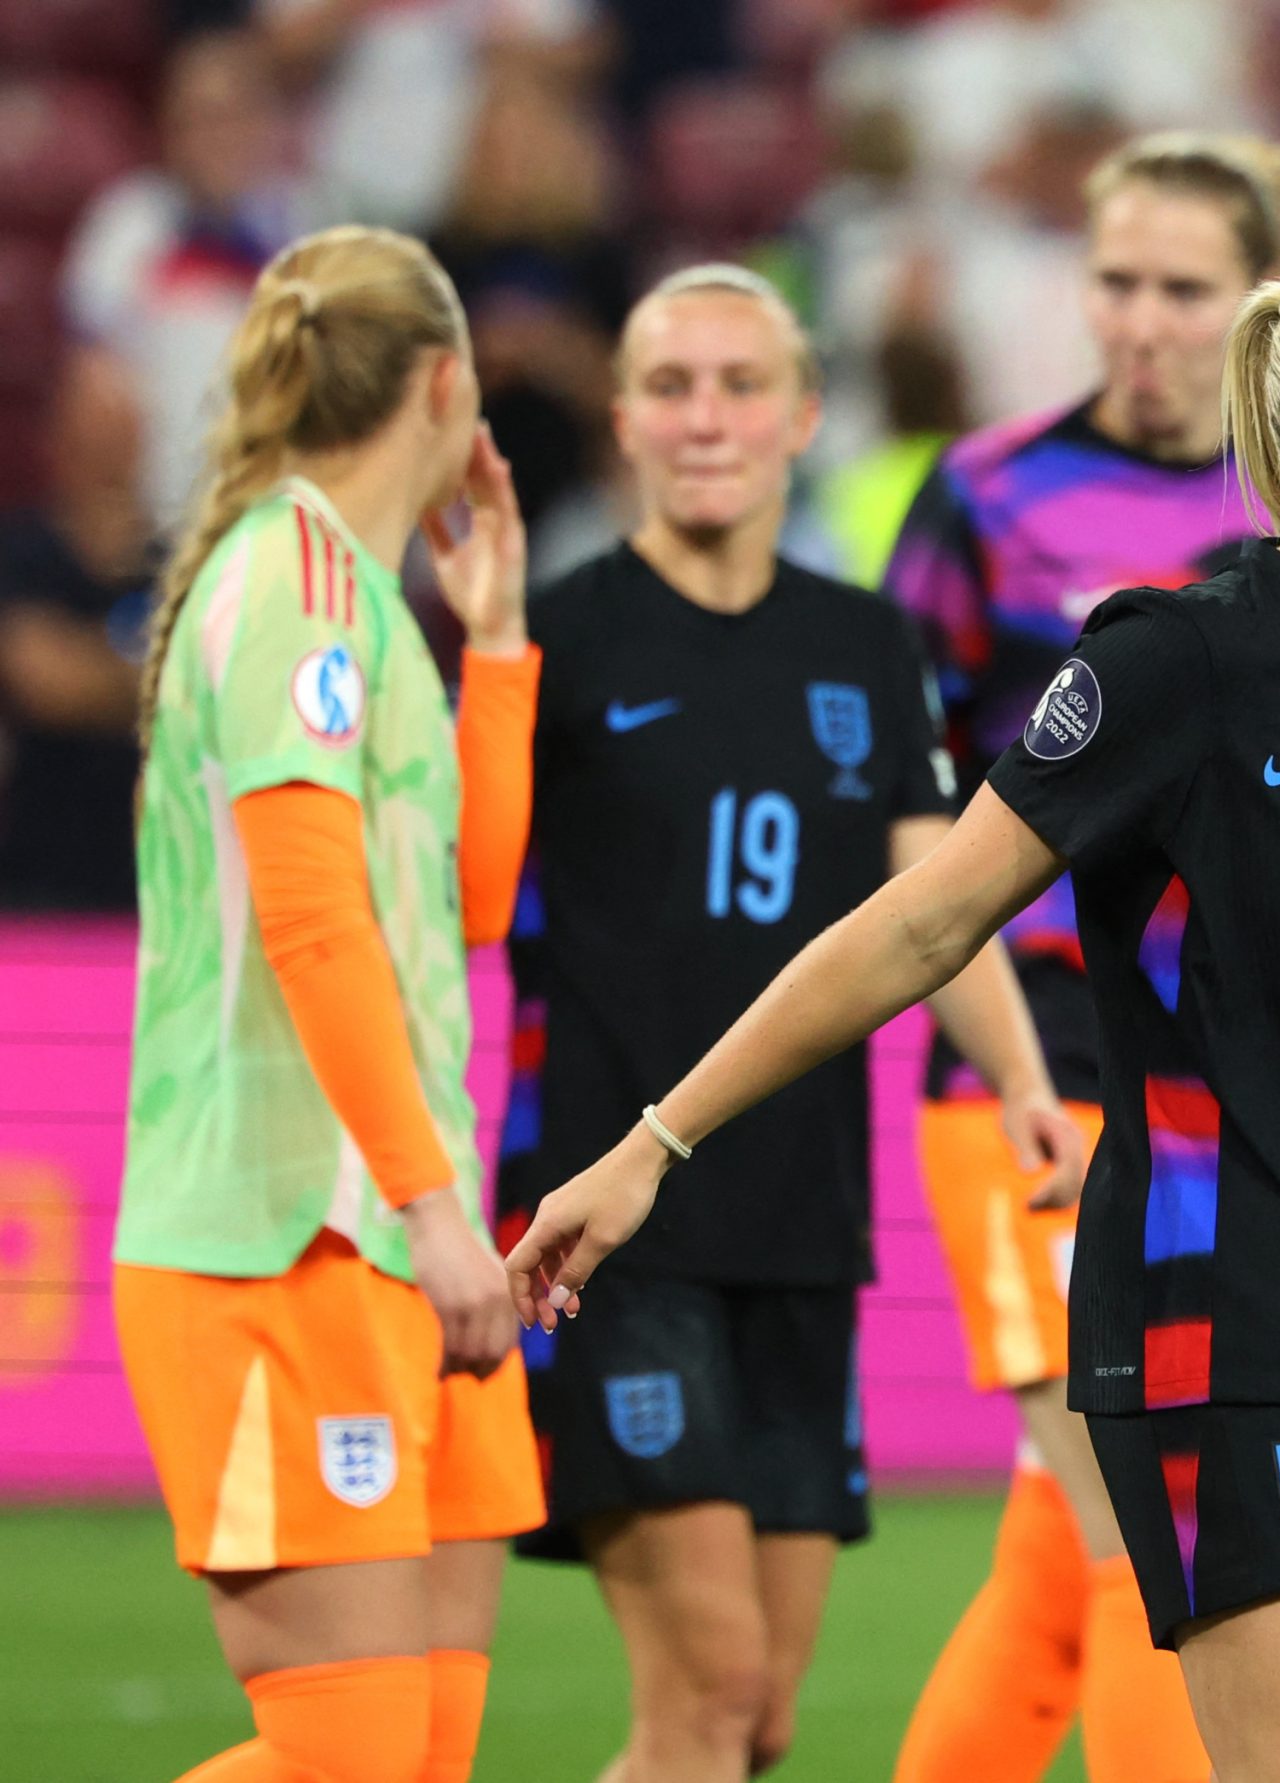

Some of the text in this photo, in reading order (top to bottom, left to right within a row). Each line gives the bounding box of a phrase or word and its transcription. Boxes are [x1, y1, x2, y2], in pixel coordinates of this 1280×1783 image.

[1054, 696, 1088, 732] EUROPEAN
[1068, 693, 1086, 714] UEFA
[1045, 719, 1069, 744] 2022
[1048, 703, 1084, 741] CHAMPIONS
[706, 785, 800, 925] 19
